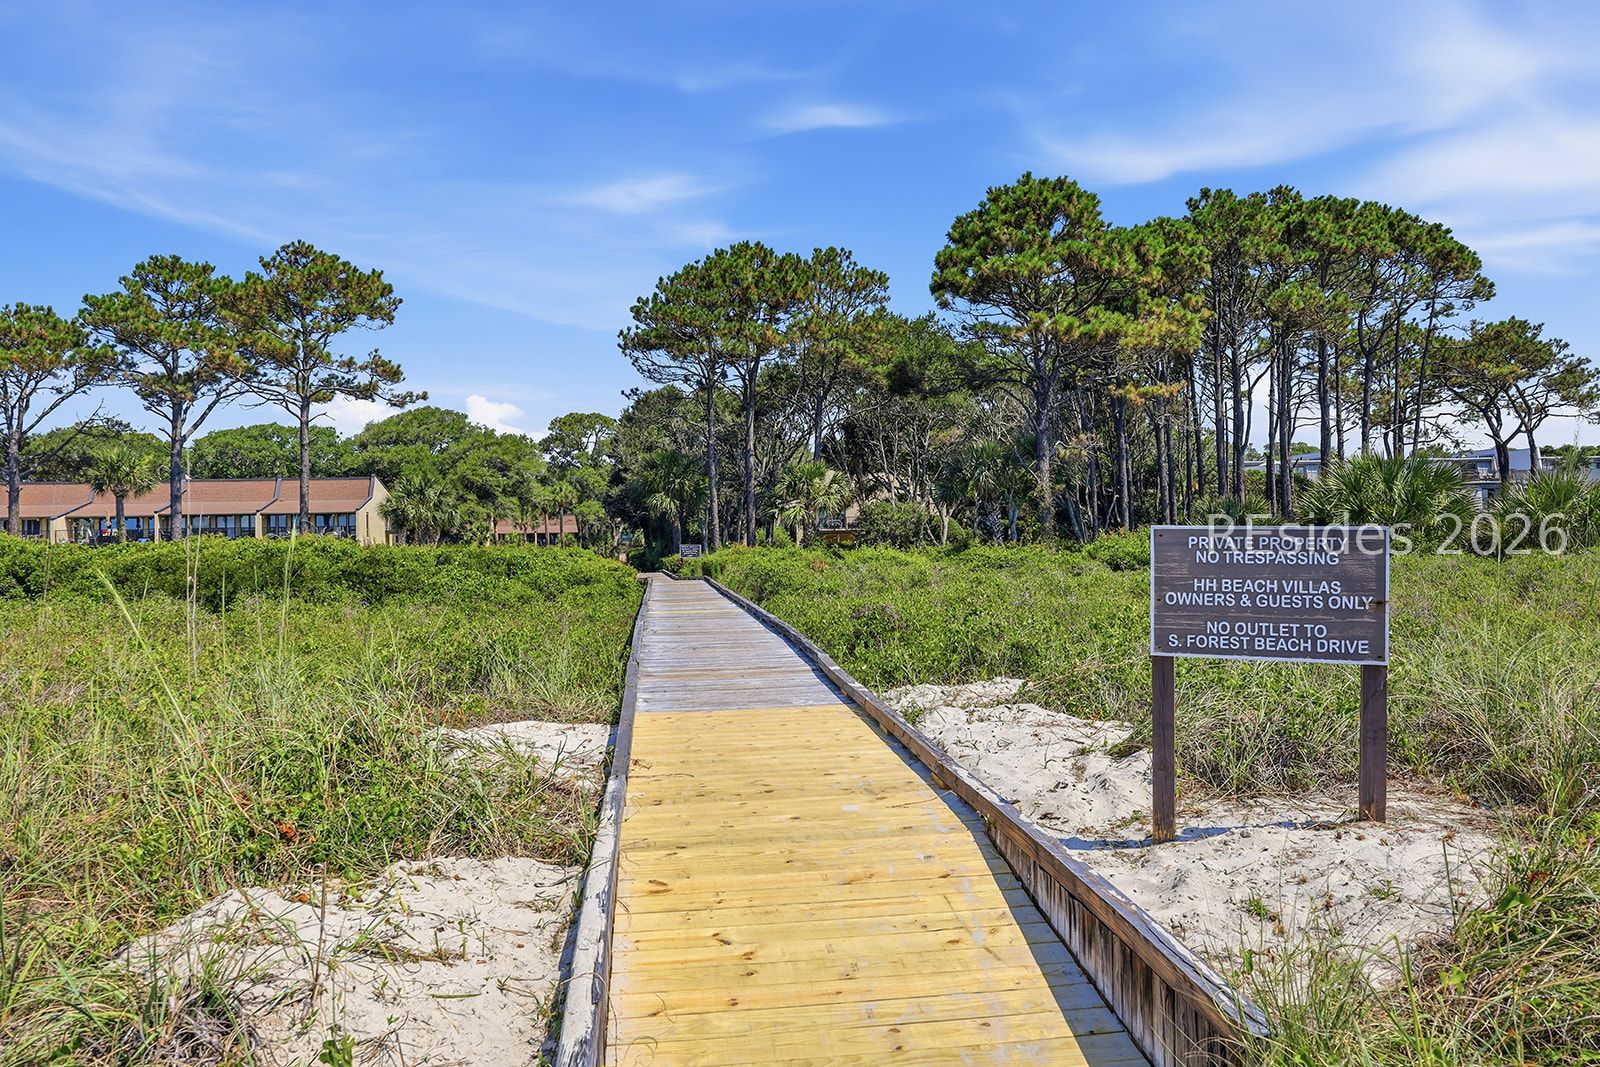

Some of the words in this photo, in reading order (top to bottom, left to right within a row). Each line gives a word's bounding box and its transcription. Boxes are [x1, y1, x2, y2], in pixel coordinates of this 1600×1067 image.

[1188, 536, 1256, 550] PRIVATE
[1259, 537, 1348, 551] PROPERTY
[1196, 551, 1220, 564] NO
[1223, 551, 1339, 566] TRESPASSING
[1194, 579, 1217, 592] HH
[1221, 579, 1278, 593] BEACH
[1281, 580, 1341, 595] VILLAS
[1165, 592, 1236, 607] OWNERS
[1240, 593, 1252, 607] &
[1256, 594, 1324, 609] GUESTS
[1328, 595, 1373, 610] ONLY
[1207, 621, 1231, 634] NO
[1235, 622, 1300, 637] OUTLET
[1304, 624, 1327, 638] TO
[1168, 634, 1182, 647] S.
[1187, 635, 1250, 650] FOREST
[1254, 638, 1312, 652] BEACH
[1317, 639, 1369, 654] DRIVE
